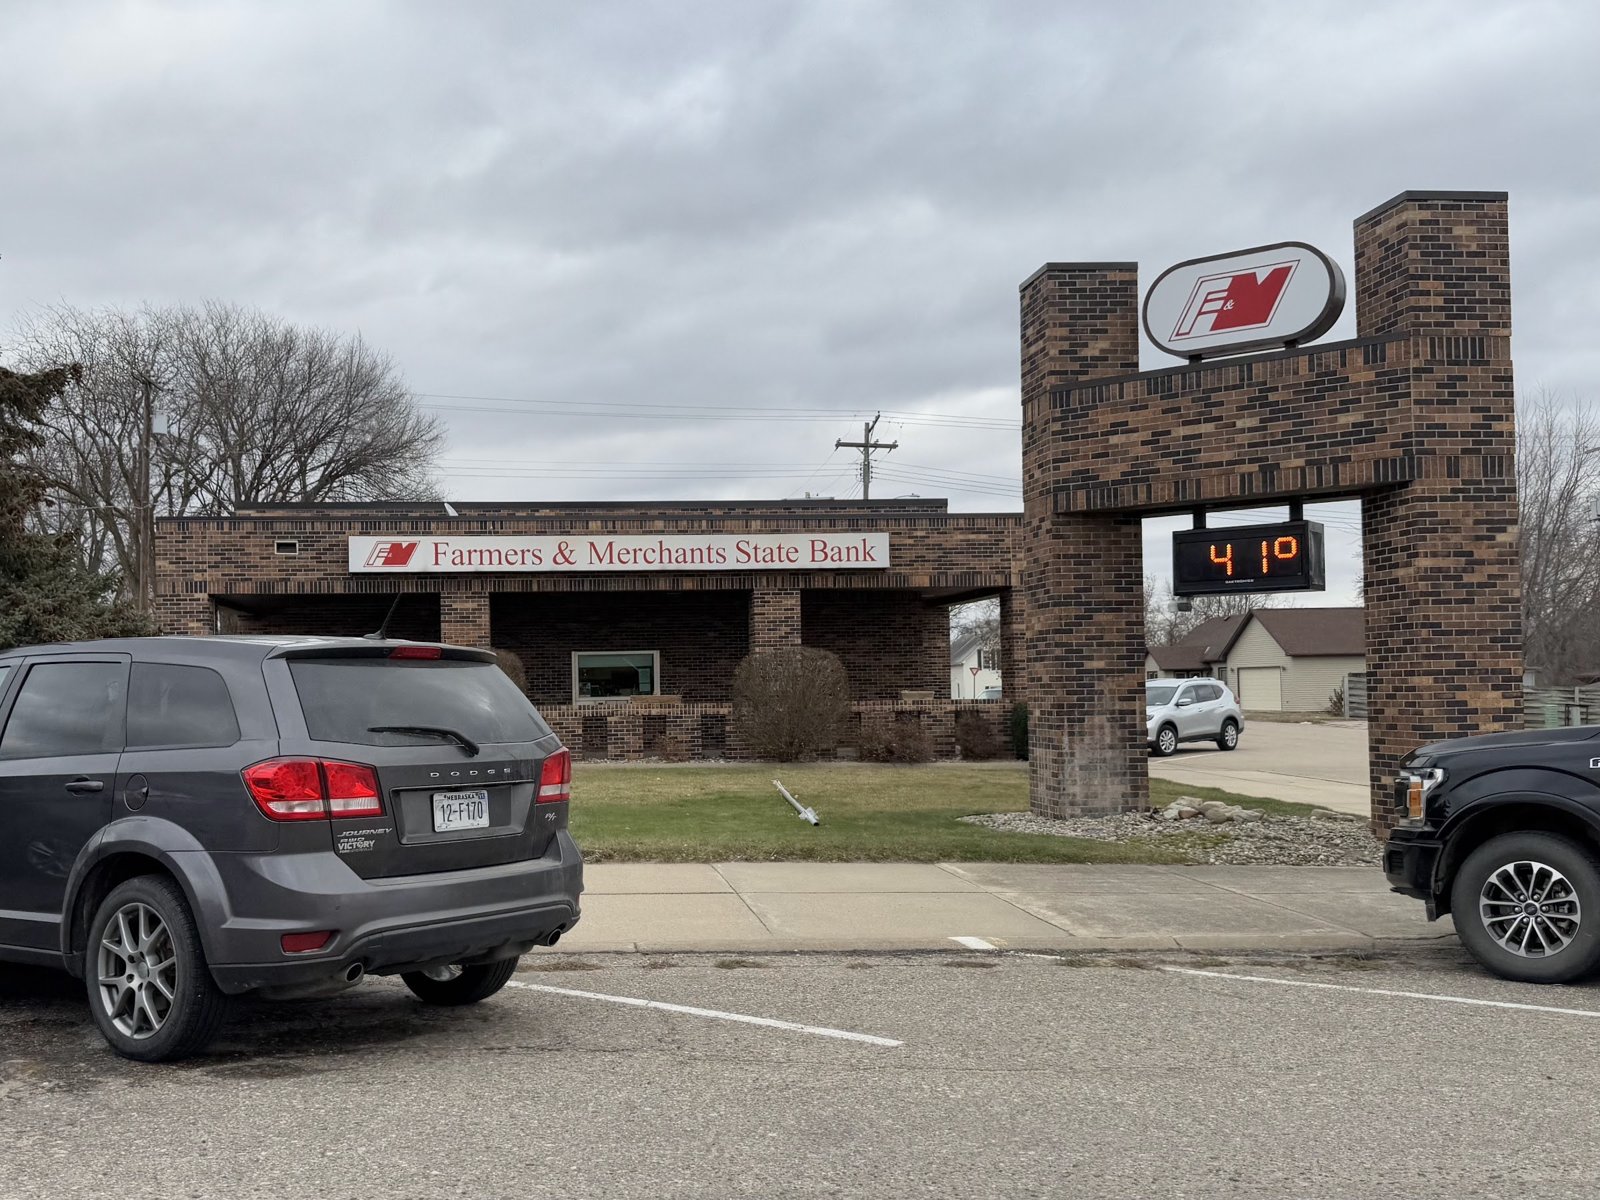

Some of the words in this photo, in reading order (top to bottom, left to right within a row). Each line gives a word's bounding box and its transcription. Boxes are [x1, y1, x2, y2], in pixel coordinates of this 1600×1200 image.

[432, 541, 543, 566] Farmers
[552, 540, 577, 565] &
[587, 540, 727, 565] Merchants
[735, 539, 799, 564] State
[808, 537, 877, 563] Bank
[430, 767, 511, 778] DODGE
[446, 793, 475, 801] NEBRASKA
[440, 801, 483, 822] 12-F170
[337, 828, 392, 837] JOURNEY
[338, 840, 375, 850] VICTORY
